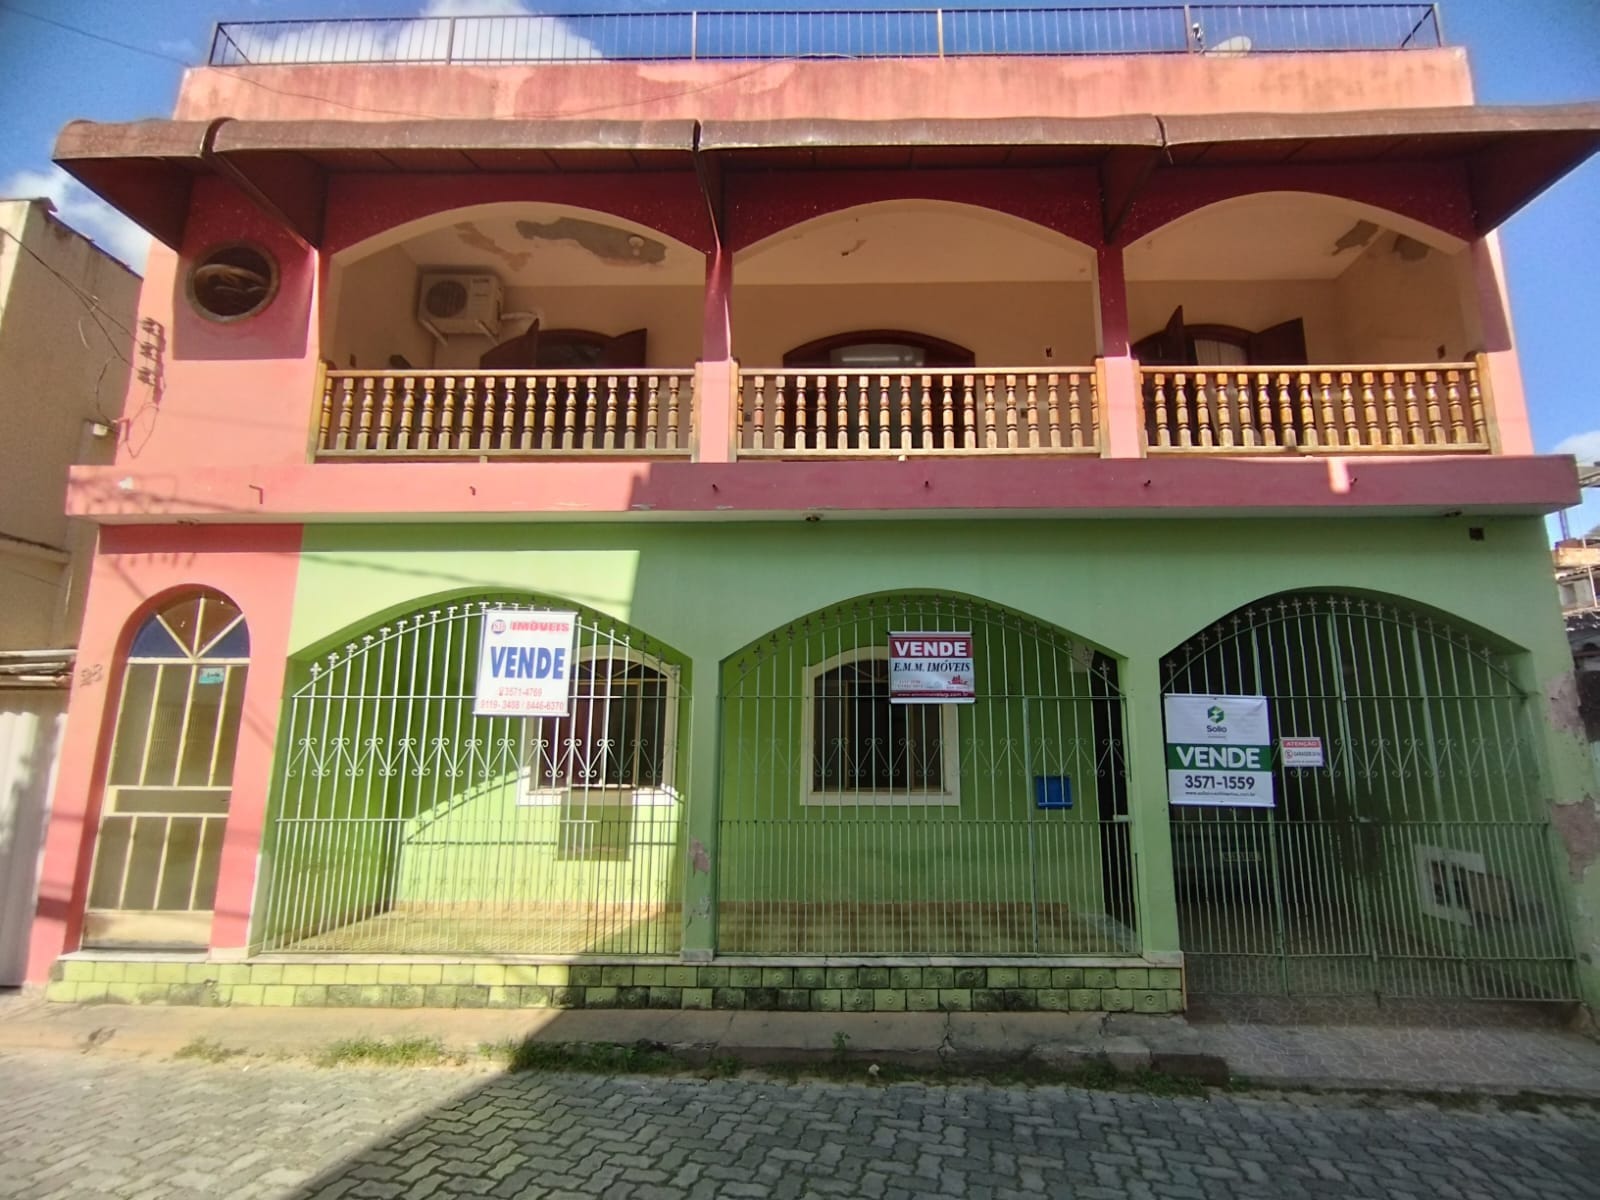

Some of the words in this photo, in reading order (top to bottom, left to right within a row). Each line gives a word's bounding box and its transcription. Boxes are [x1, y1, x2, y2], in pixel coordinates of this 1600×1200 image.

[894, 641, 967, 657] VENDE
[490, 646, 566, 679] VENDE
[893, 662, 925, 673] E.M.M.
[927, 660, 970, 673] IMÓVEIS
[1176, 746, 1261, 769] VENDE
[1185, 775, 1255, 790] 3571-1559
